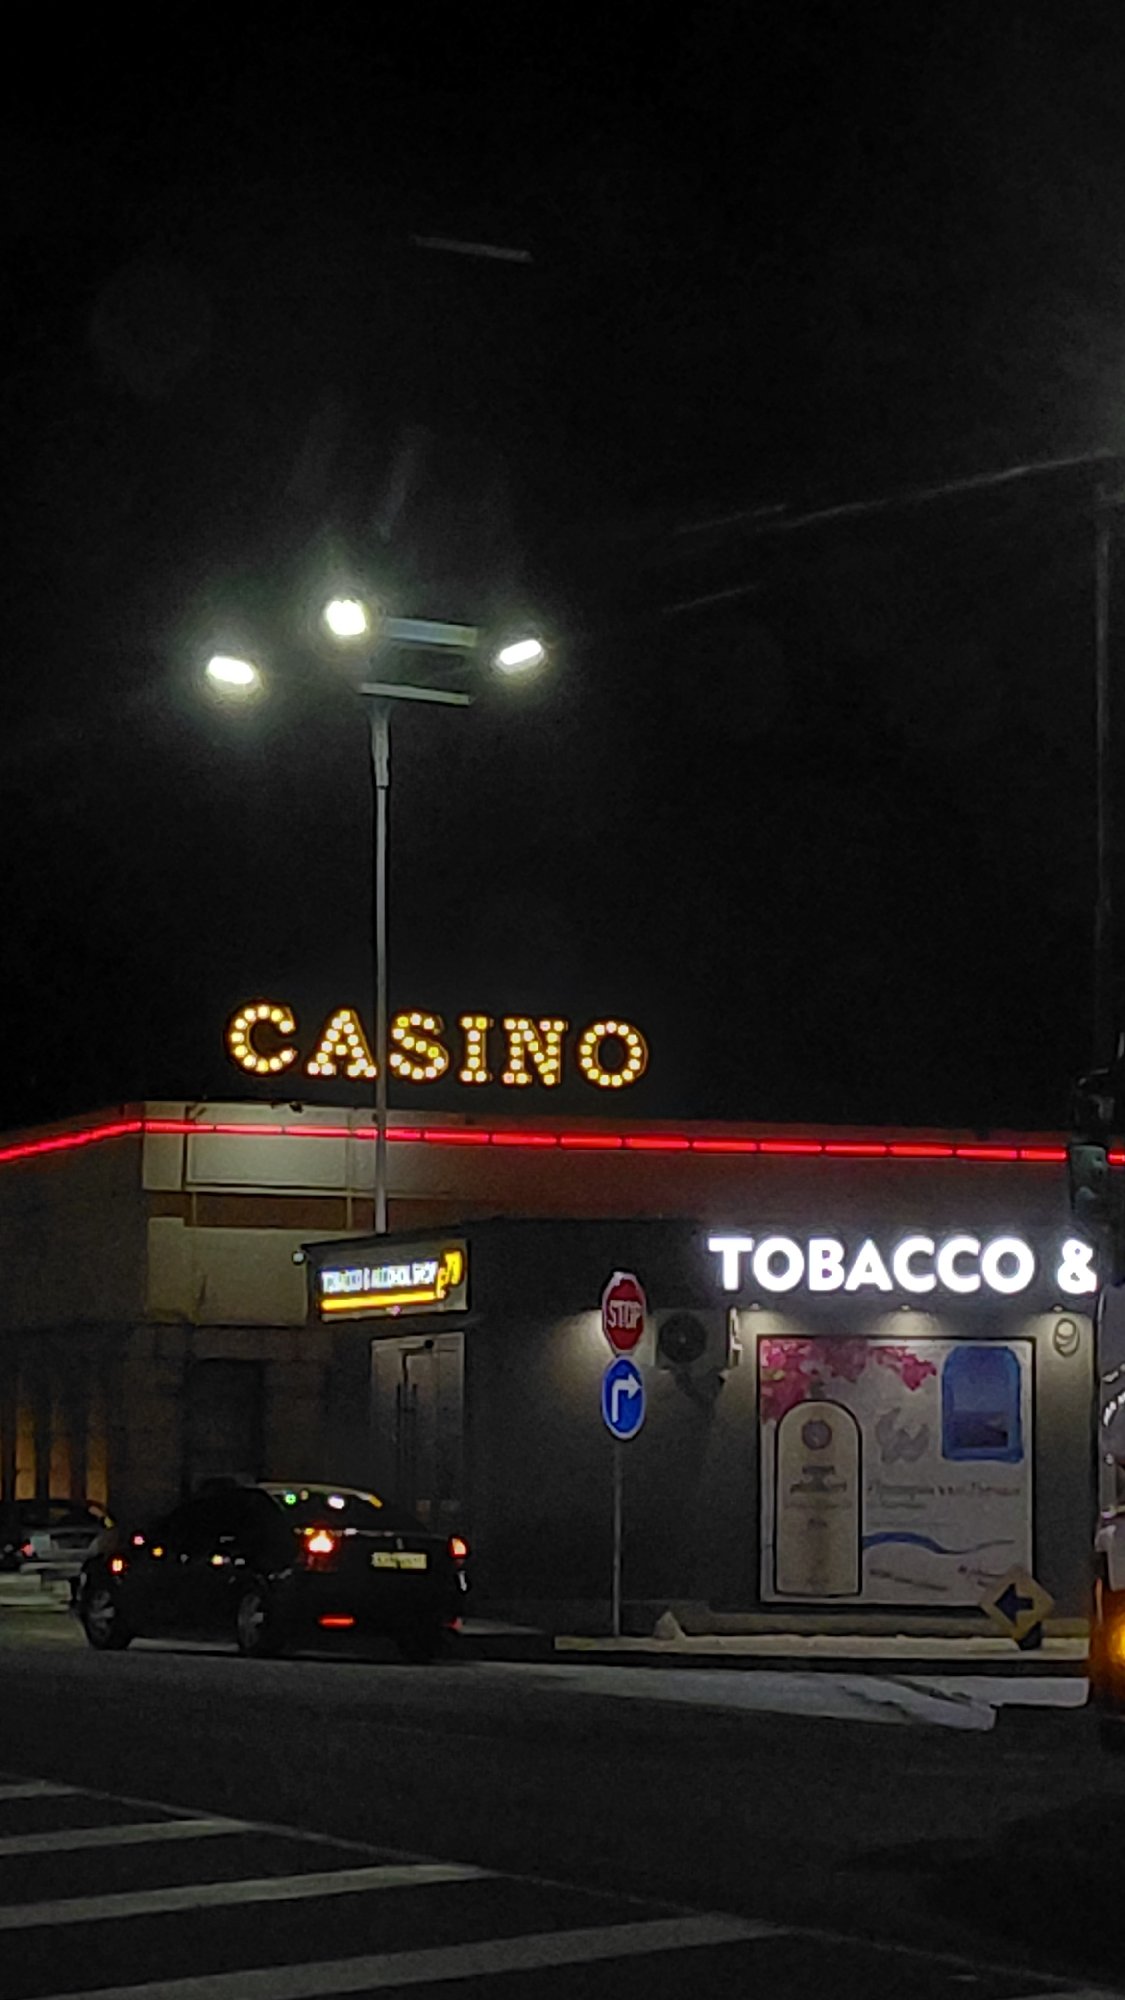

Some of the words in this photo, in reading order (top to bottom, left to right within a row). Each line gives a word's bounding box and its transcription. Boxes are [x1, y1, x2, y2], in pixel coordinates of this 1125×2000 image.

[228, 1002, 647, 1088] CASINO
[708, 1236, 1035, 1294] TOBACCO
[1057, 1238, 1098, 1294] &
[608, 1301, 642, 1329] STOP
